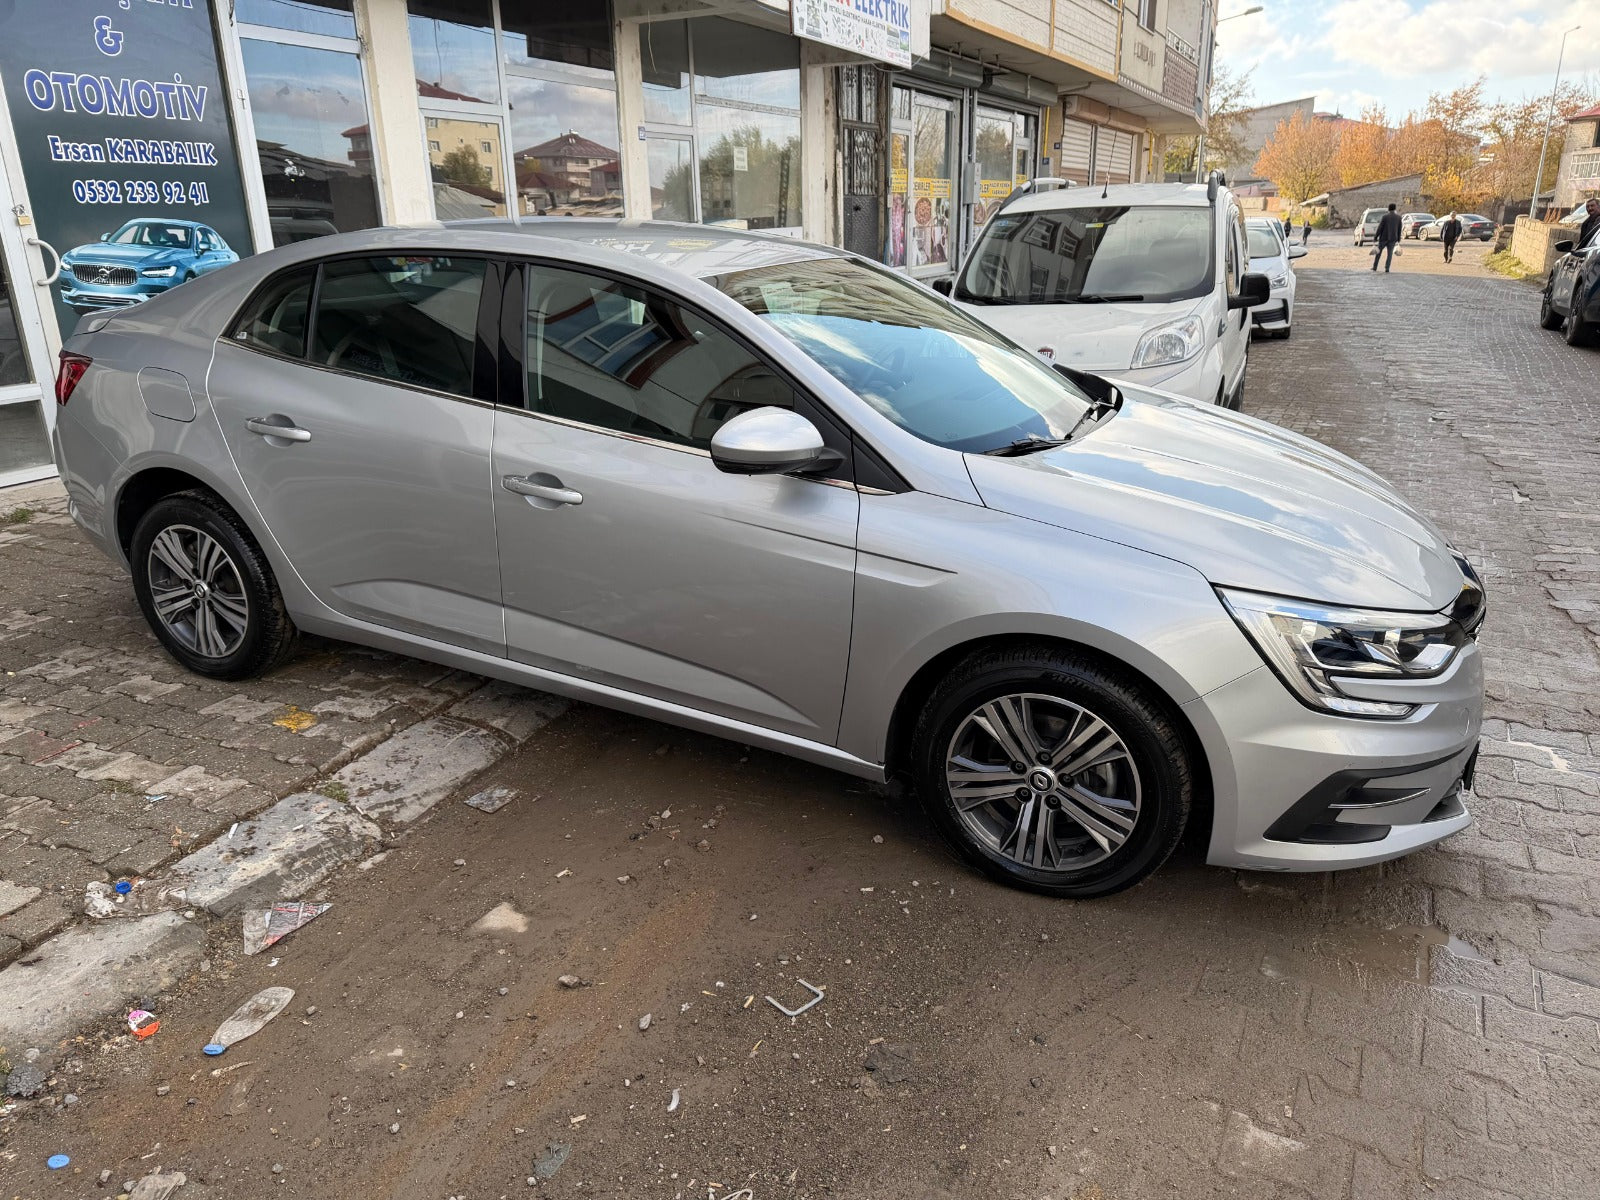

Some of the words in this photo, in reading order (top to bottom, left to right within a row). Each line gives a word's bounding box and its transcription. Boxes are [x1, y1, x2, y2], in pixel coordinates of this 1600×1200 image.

[94, 15, 124, 57] &
[23, 68, 208, 122] OTOMOTİV
[47, 135, 104, 162] Ersan
[105, 137, 218, 166] KARABALIK
[72, 179, 122, 204] 0532
[124, 180, 159, 204] 233
[163, 181, 186, 204] 92
[188, 181, 209, 206] 41
